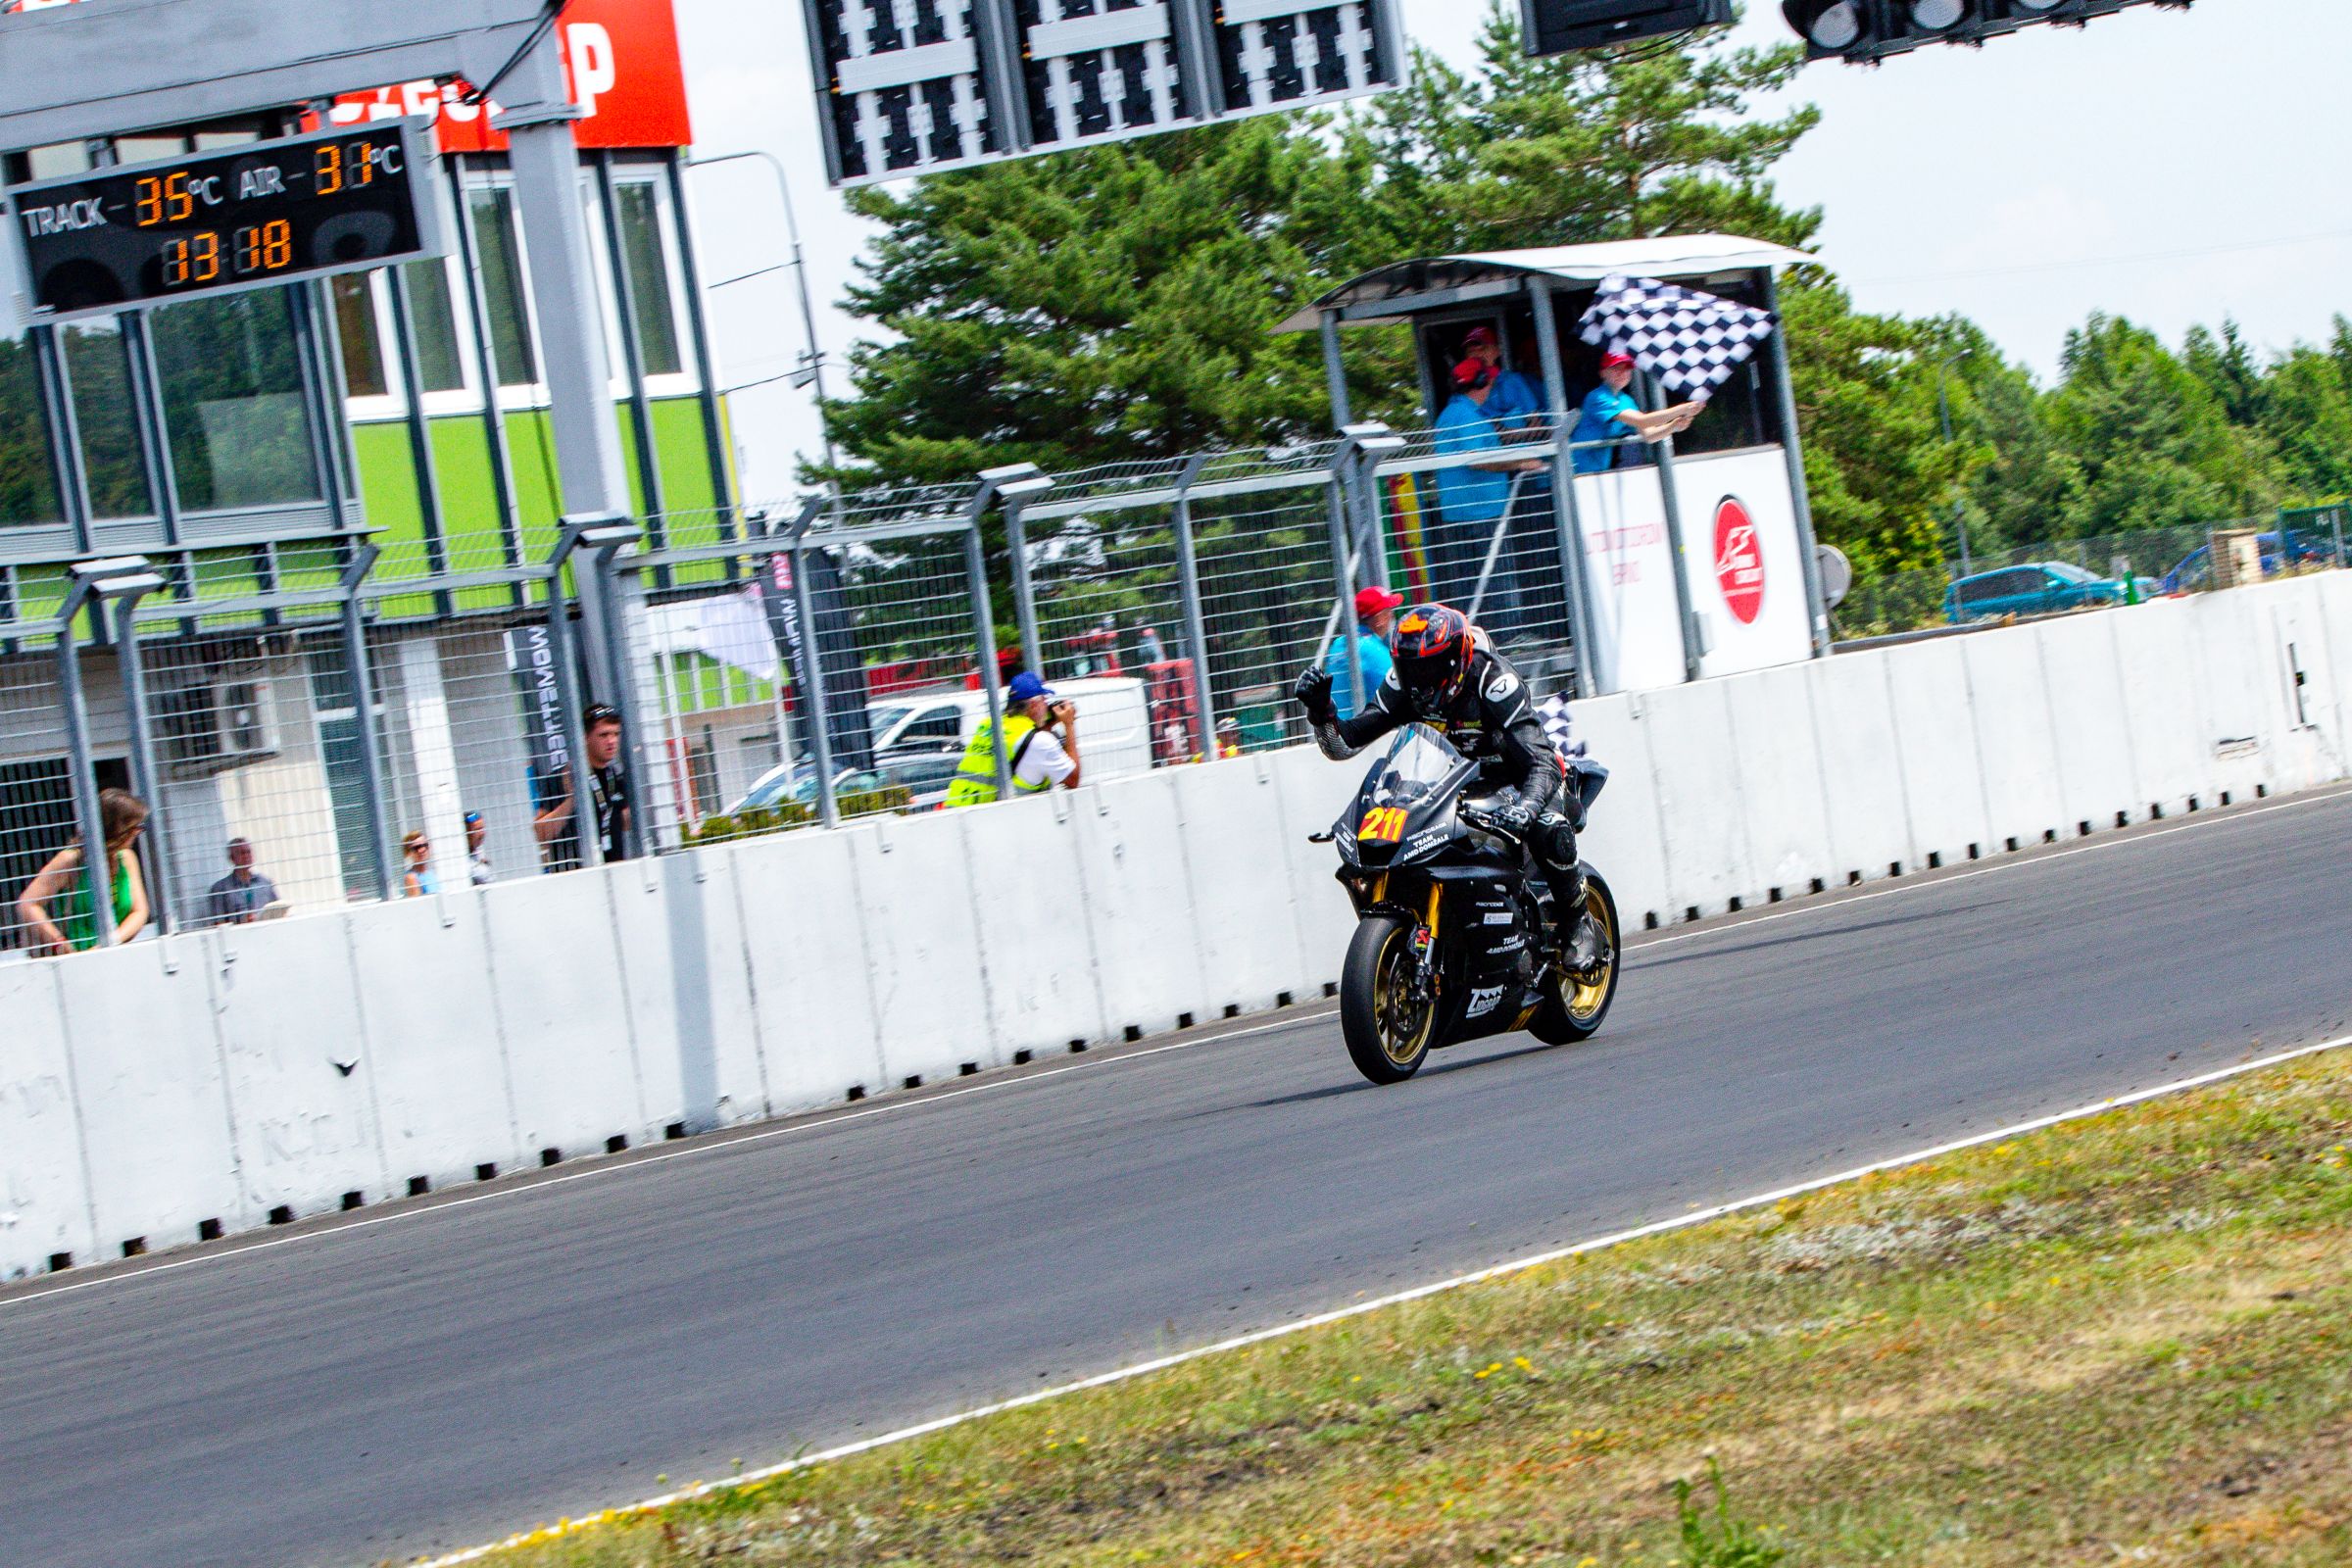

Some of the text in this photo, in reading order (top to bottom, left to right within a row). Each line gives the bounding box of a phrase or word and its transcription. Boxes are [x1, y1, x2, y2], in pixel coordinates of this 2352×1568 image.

[22, 197, 107, 237] TRACK
[240, 165, 286, 200] AIR
[1358, 807, 1406, 842] 211
[1412, 833, 1434, 848] TEAM
